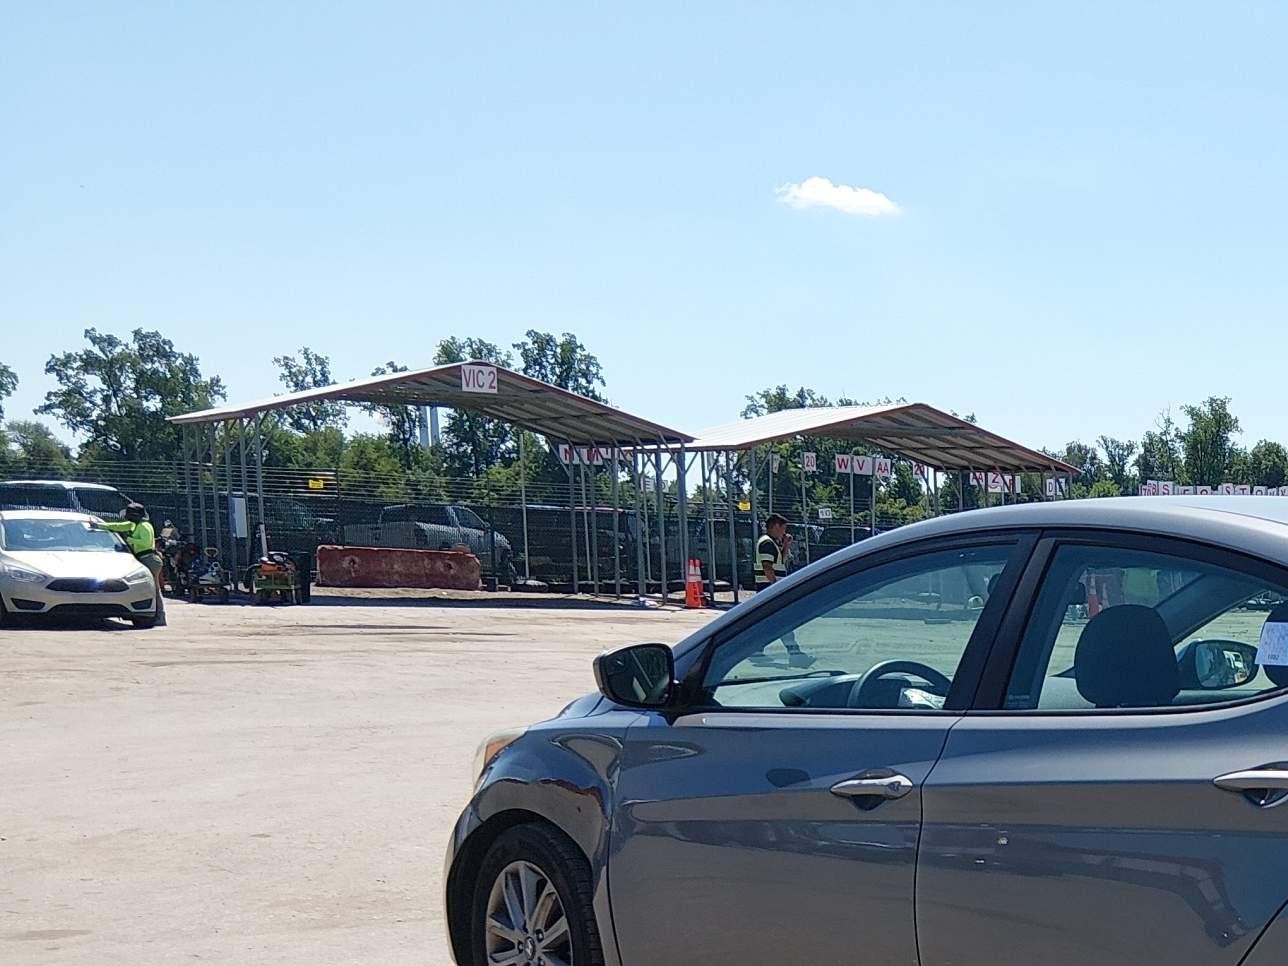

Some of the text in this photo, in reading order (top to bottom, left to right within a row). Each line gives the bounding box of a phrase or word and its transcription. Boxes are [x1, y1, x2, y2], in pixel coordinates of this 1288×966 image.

[462, 368, 496, 390] VIC 2
[805, 455, 815, 468] 20
[837, 458, 849, 470] W
[856, 459, 865, 471] V
[877, 463, 889, 473] AA
